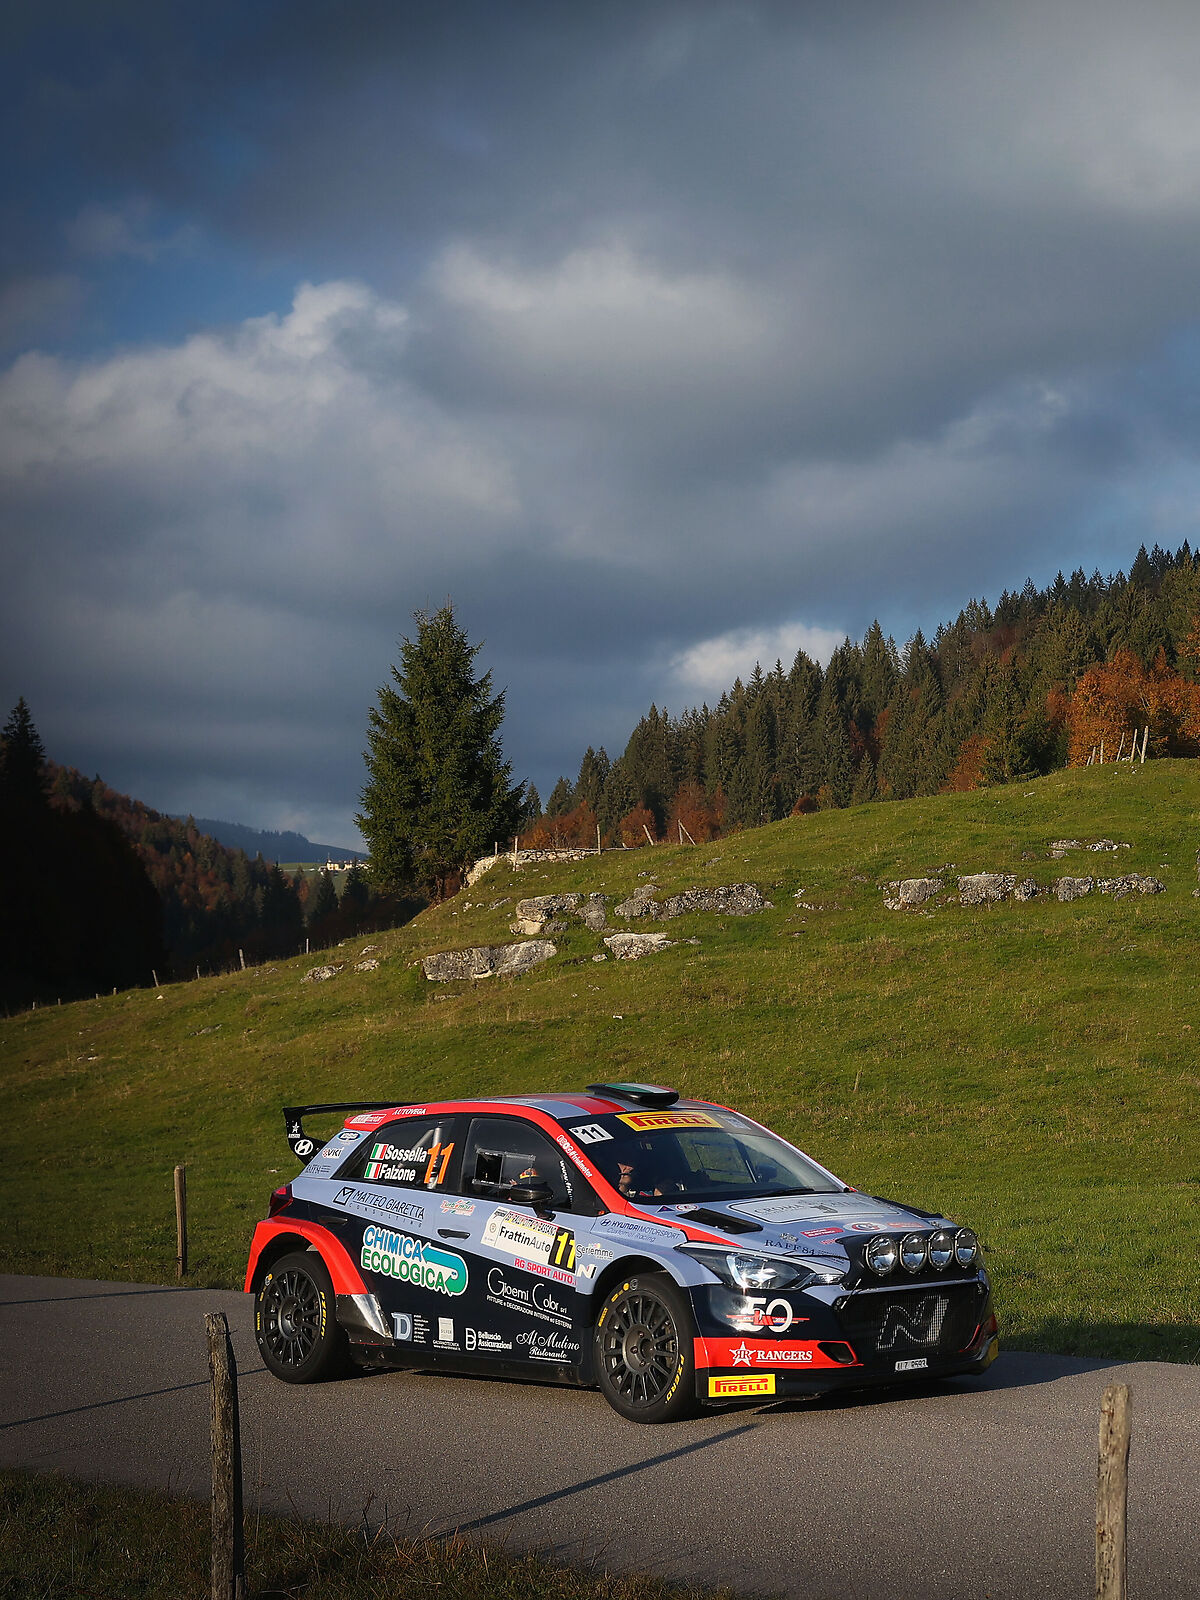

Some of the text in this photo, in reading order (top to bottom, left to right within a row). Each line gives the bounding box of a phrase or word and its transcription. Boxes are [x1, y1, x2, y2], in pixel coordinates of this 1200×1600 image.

[628, 1113, 712, 1127] PIRELLI
[581, 1126, 606, 1140] 11
[385, 1144, 428, 1163] Sossella
[379, 1164, 416, 1181] Falzone
[424, 1142, 455, 1185] 11
[352, 1190, 426, 1220] MATTEO GIARETTA
[349, 1203, 422, 1228] CONSULTING
[611, 1221, 641, 1232] HYUNDAI
[364, 1226, 422, 1263] CHIMICA
[499, 1225, 551, 1253] FrattinAuto
[554, 1231, 576, 1269] 11
[576, 1244, 614, 1259] Seriemme
[362, 1247, 446, 1292] ECOLOGICA
[514, 1258, 526, 1269] RG
[527, 1261, 551, 1277] SPORT
[487, 1267, 529, 1301] Gioemi
[532, 1283, 559, 1311] Color
[537, 1331, 580, 1351] Mulino
[756, 1350, 813, 1361] RANGERS
[714, 1378, 769, 1393] PIRELLI
